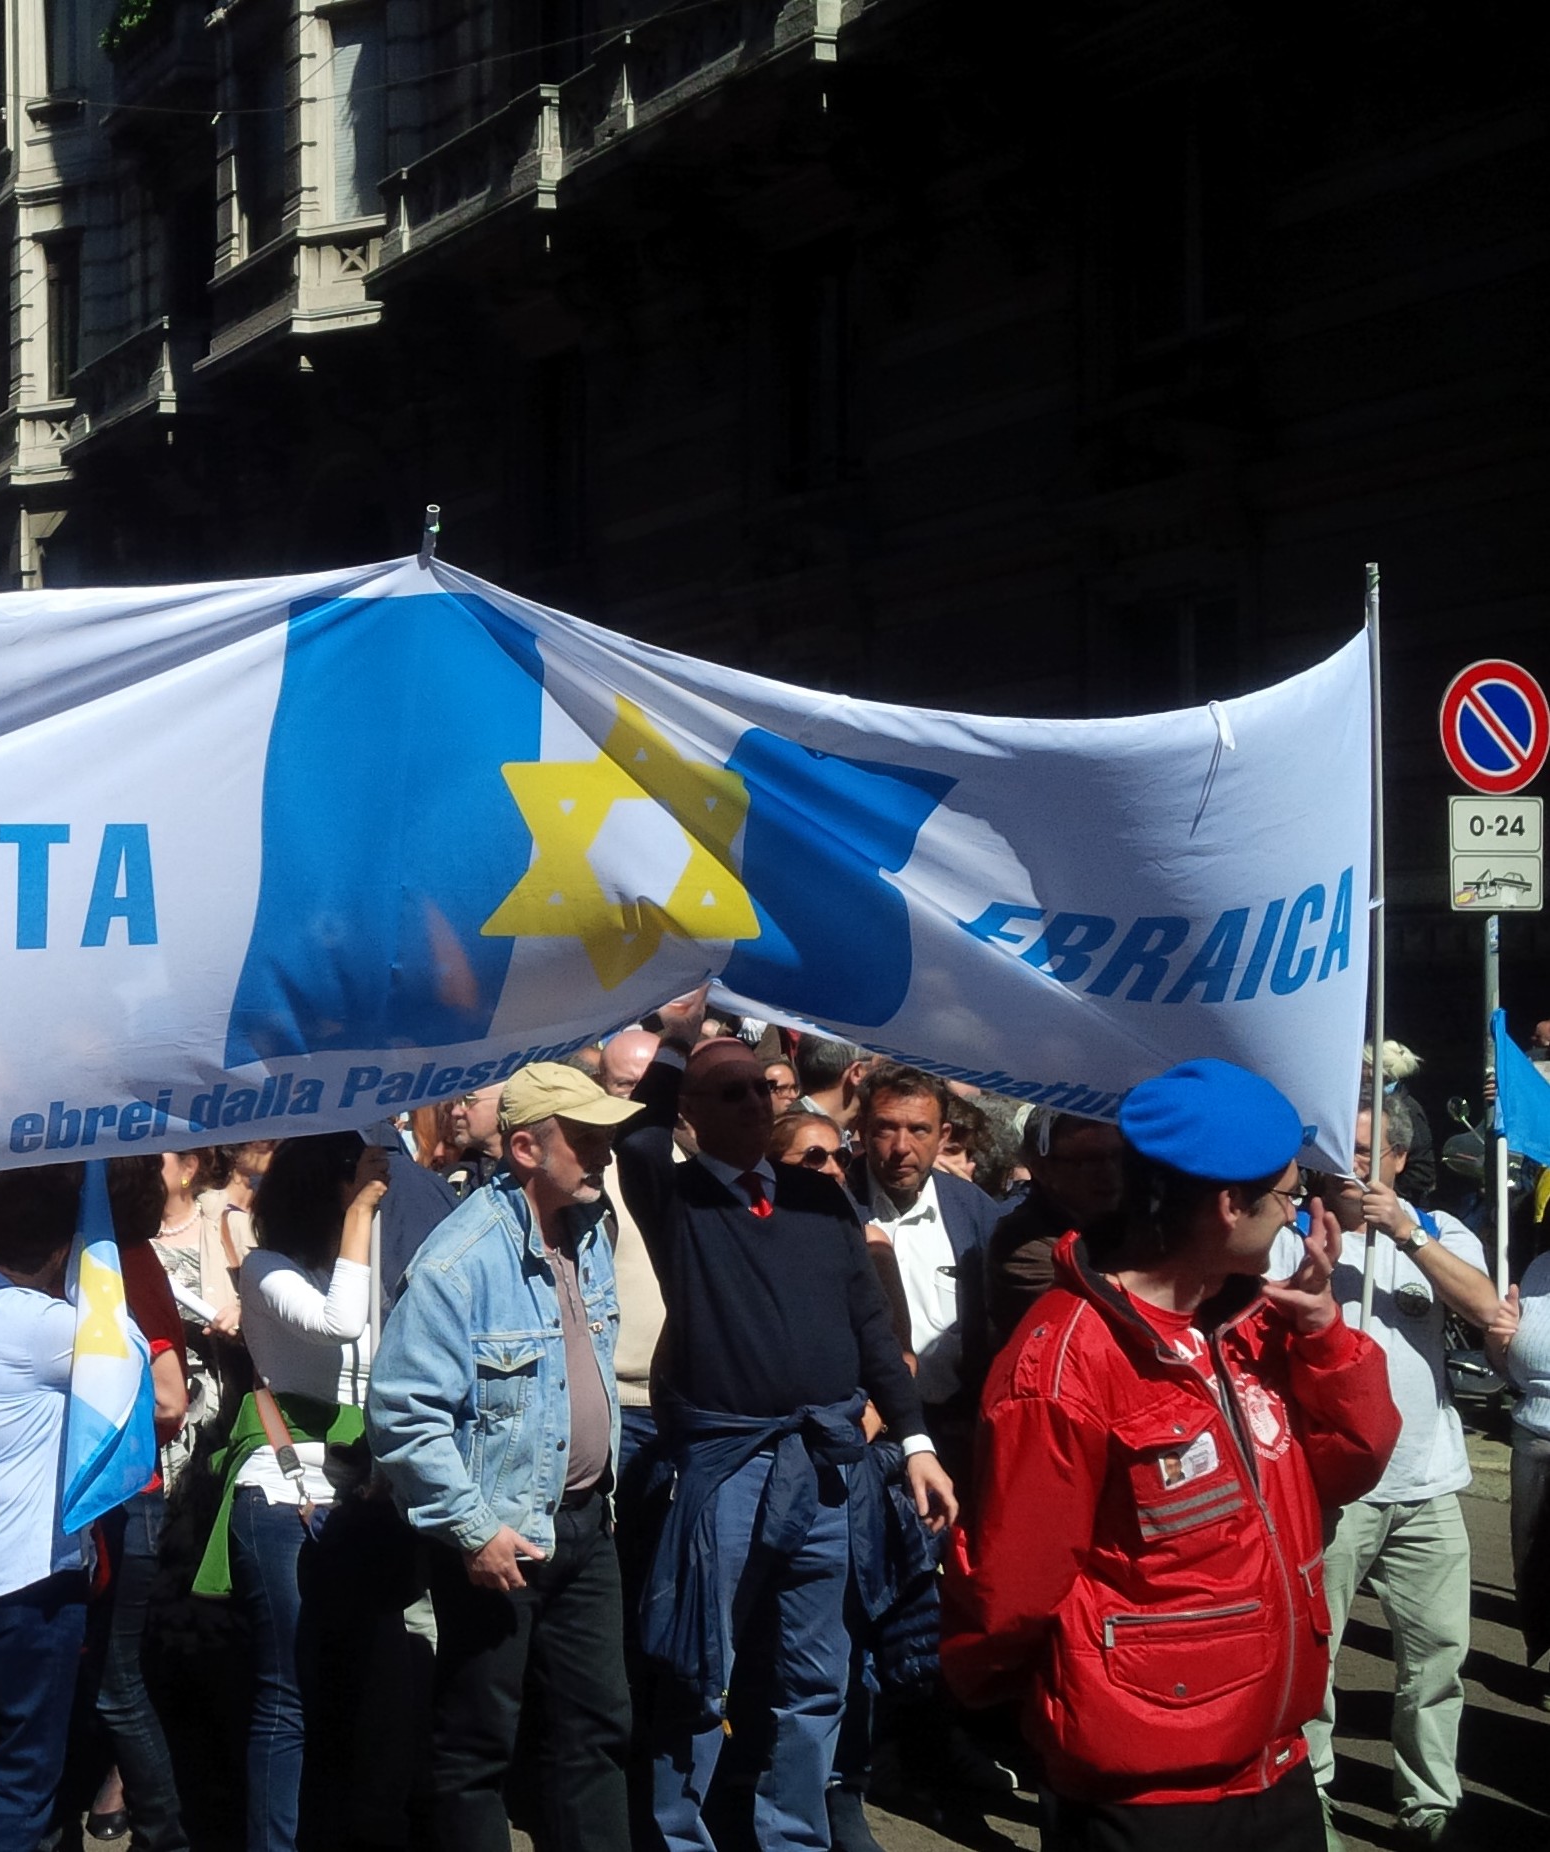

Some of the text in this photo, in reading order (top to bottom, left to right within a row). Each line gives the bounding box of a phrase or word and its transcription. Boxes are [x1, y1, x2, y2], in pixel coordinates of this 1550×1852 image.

[1469, 814, 1525, 837] 0-24
[957, 865, 1354, 1004] EBRAICA
[9, 1089, 173, 1154] ebrei
[189, 1075, 326, 1132] dalla
